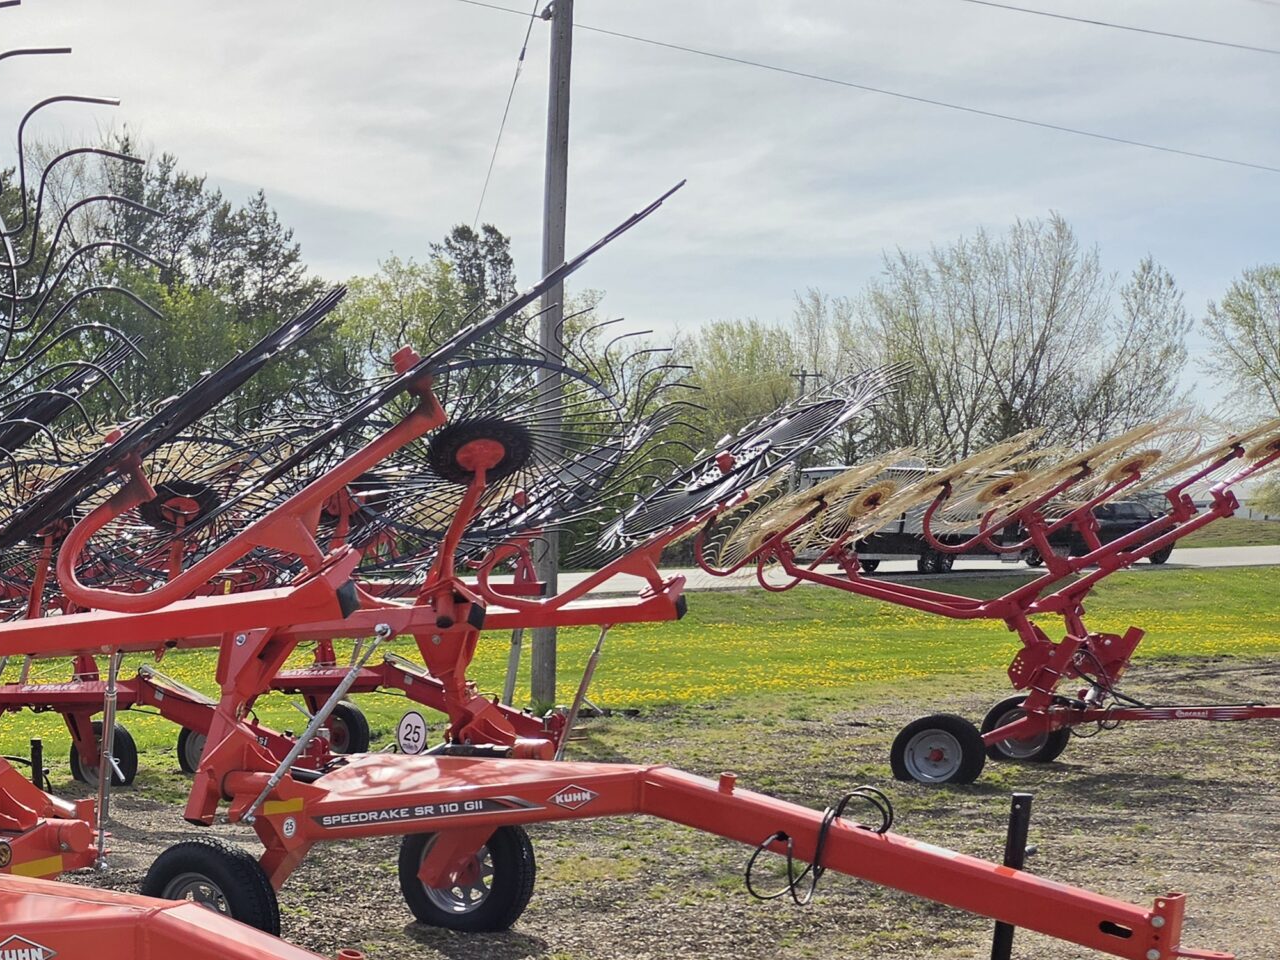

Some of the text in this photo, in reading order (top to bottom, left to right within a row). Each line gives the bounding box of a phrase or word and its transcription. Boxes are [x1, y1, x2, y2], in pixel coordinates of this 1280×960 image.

[404, 723, 421, 743] 25
[556, 791, 591, 804] KUHN
[322, 800, 483, 826] SPEEDRAKE SR 110 GII
[285, 821, 294, 831] 25
